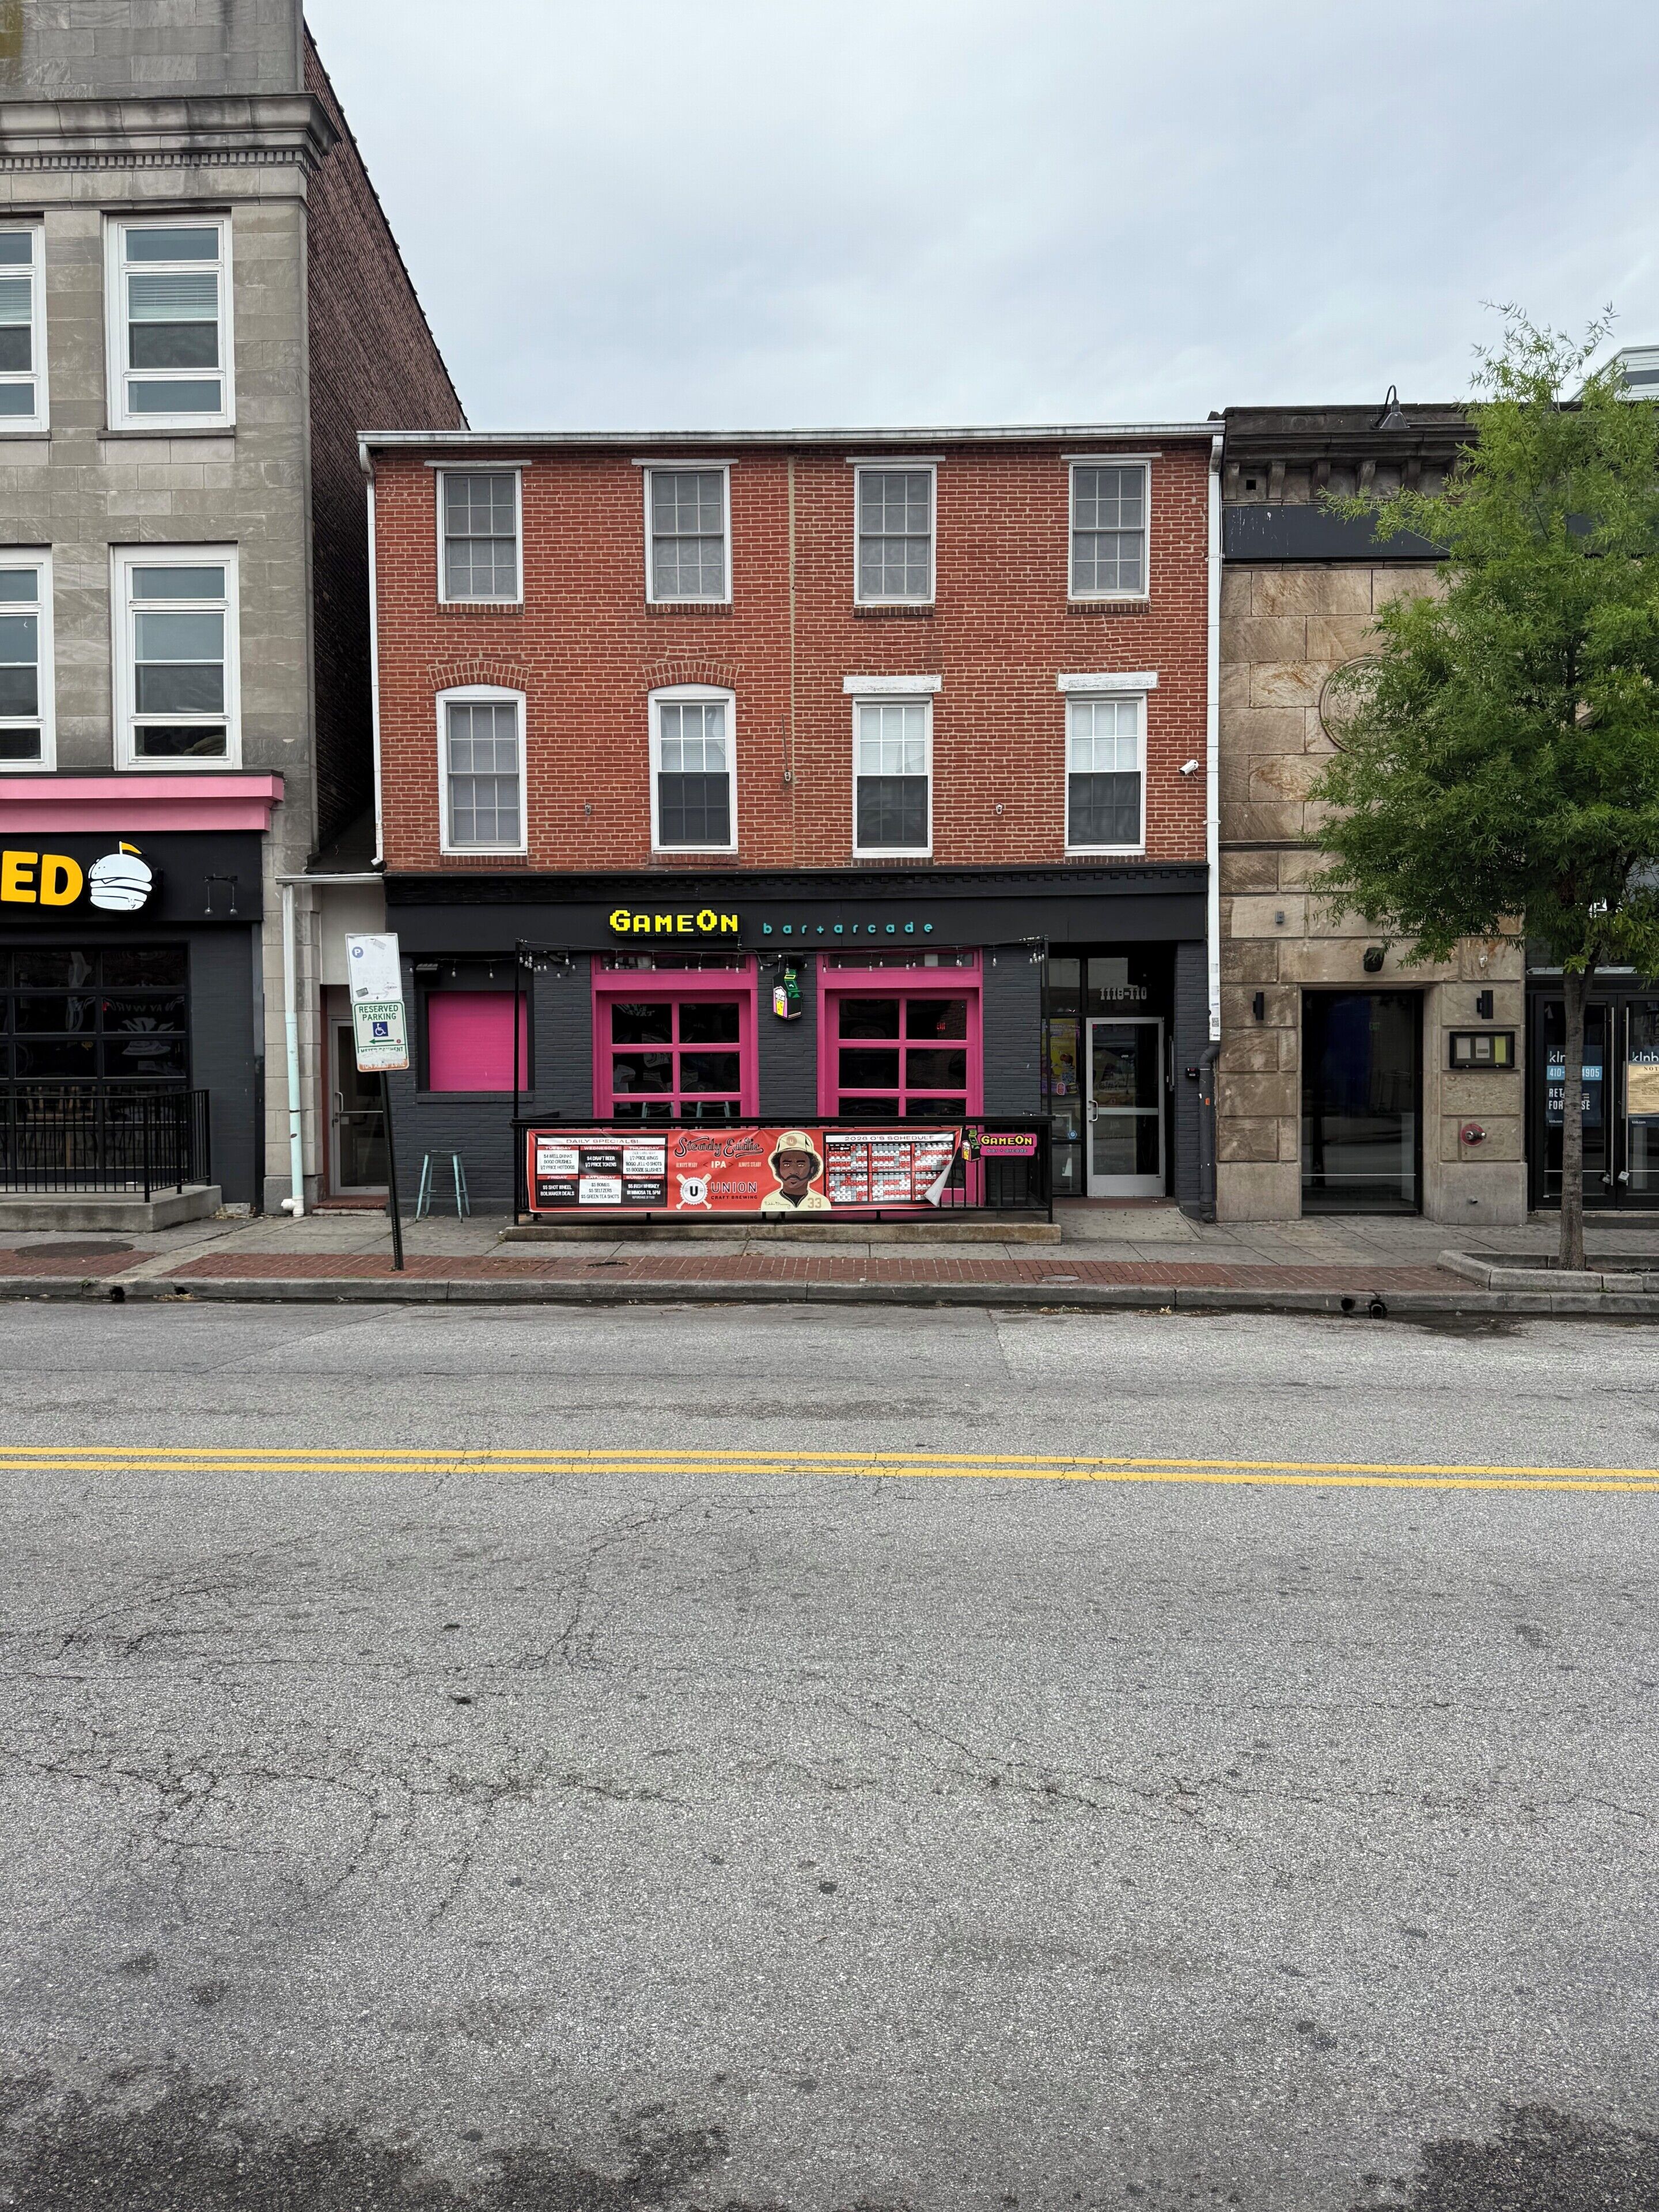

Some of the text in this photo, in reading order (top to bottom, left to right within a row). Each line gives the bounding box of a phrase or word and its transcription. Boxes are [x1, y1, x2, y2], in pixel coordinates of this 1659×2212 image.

[1, 851, 83, 906] ED
[359, 1005, 399, 1013] RESERVED
[362, 1013, 396, 1021] PARKING
[1548, 1100, 1563, 1110] FOR
[675, 1136, 764, 1158] Steady Eddie
[690, 1186, 698, 1196] U
[711, 1181, 757, 1194] UNION
[808, 1198, 821, 1208] 33
